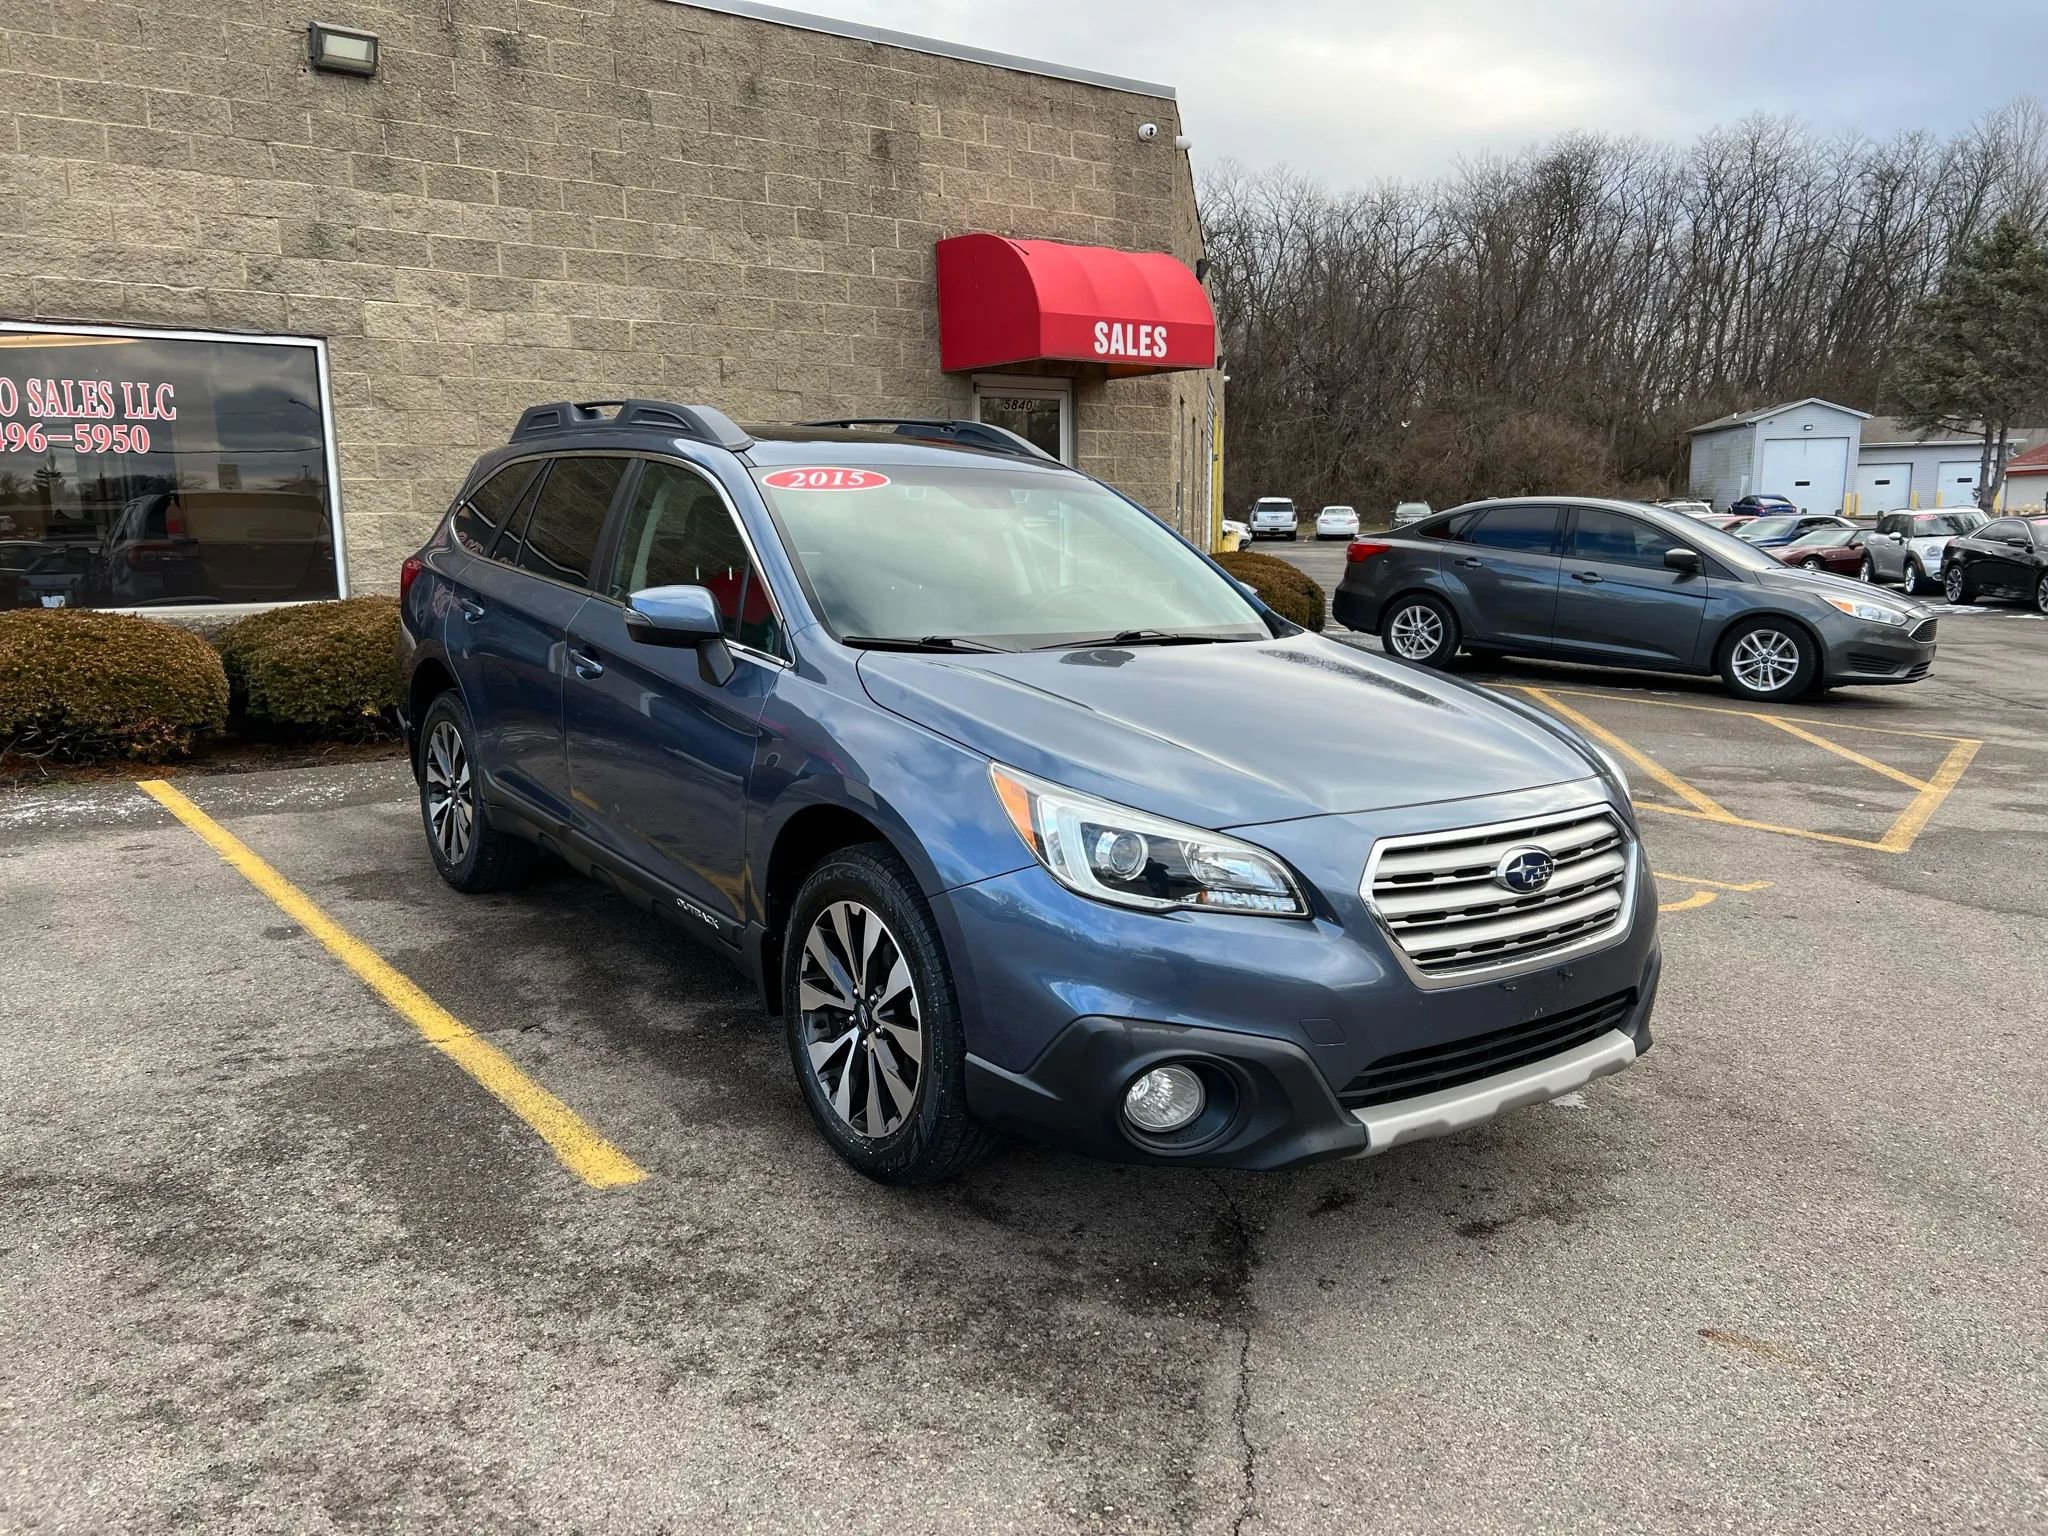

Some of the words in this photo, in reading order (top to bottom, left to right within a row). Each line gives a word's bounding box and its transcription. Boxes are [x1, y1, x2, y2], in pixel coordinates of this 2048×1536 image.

[1094, 321, 1168, 358] SALES
[27, 378, 115, 419] SALES
[123, 382, 177, 420] LLC
[1003, 399, 1033, 411] 5840
[788, 470, 865, 488] 2015
